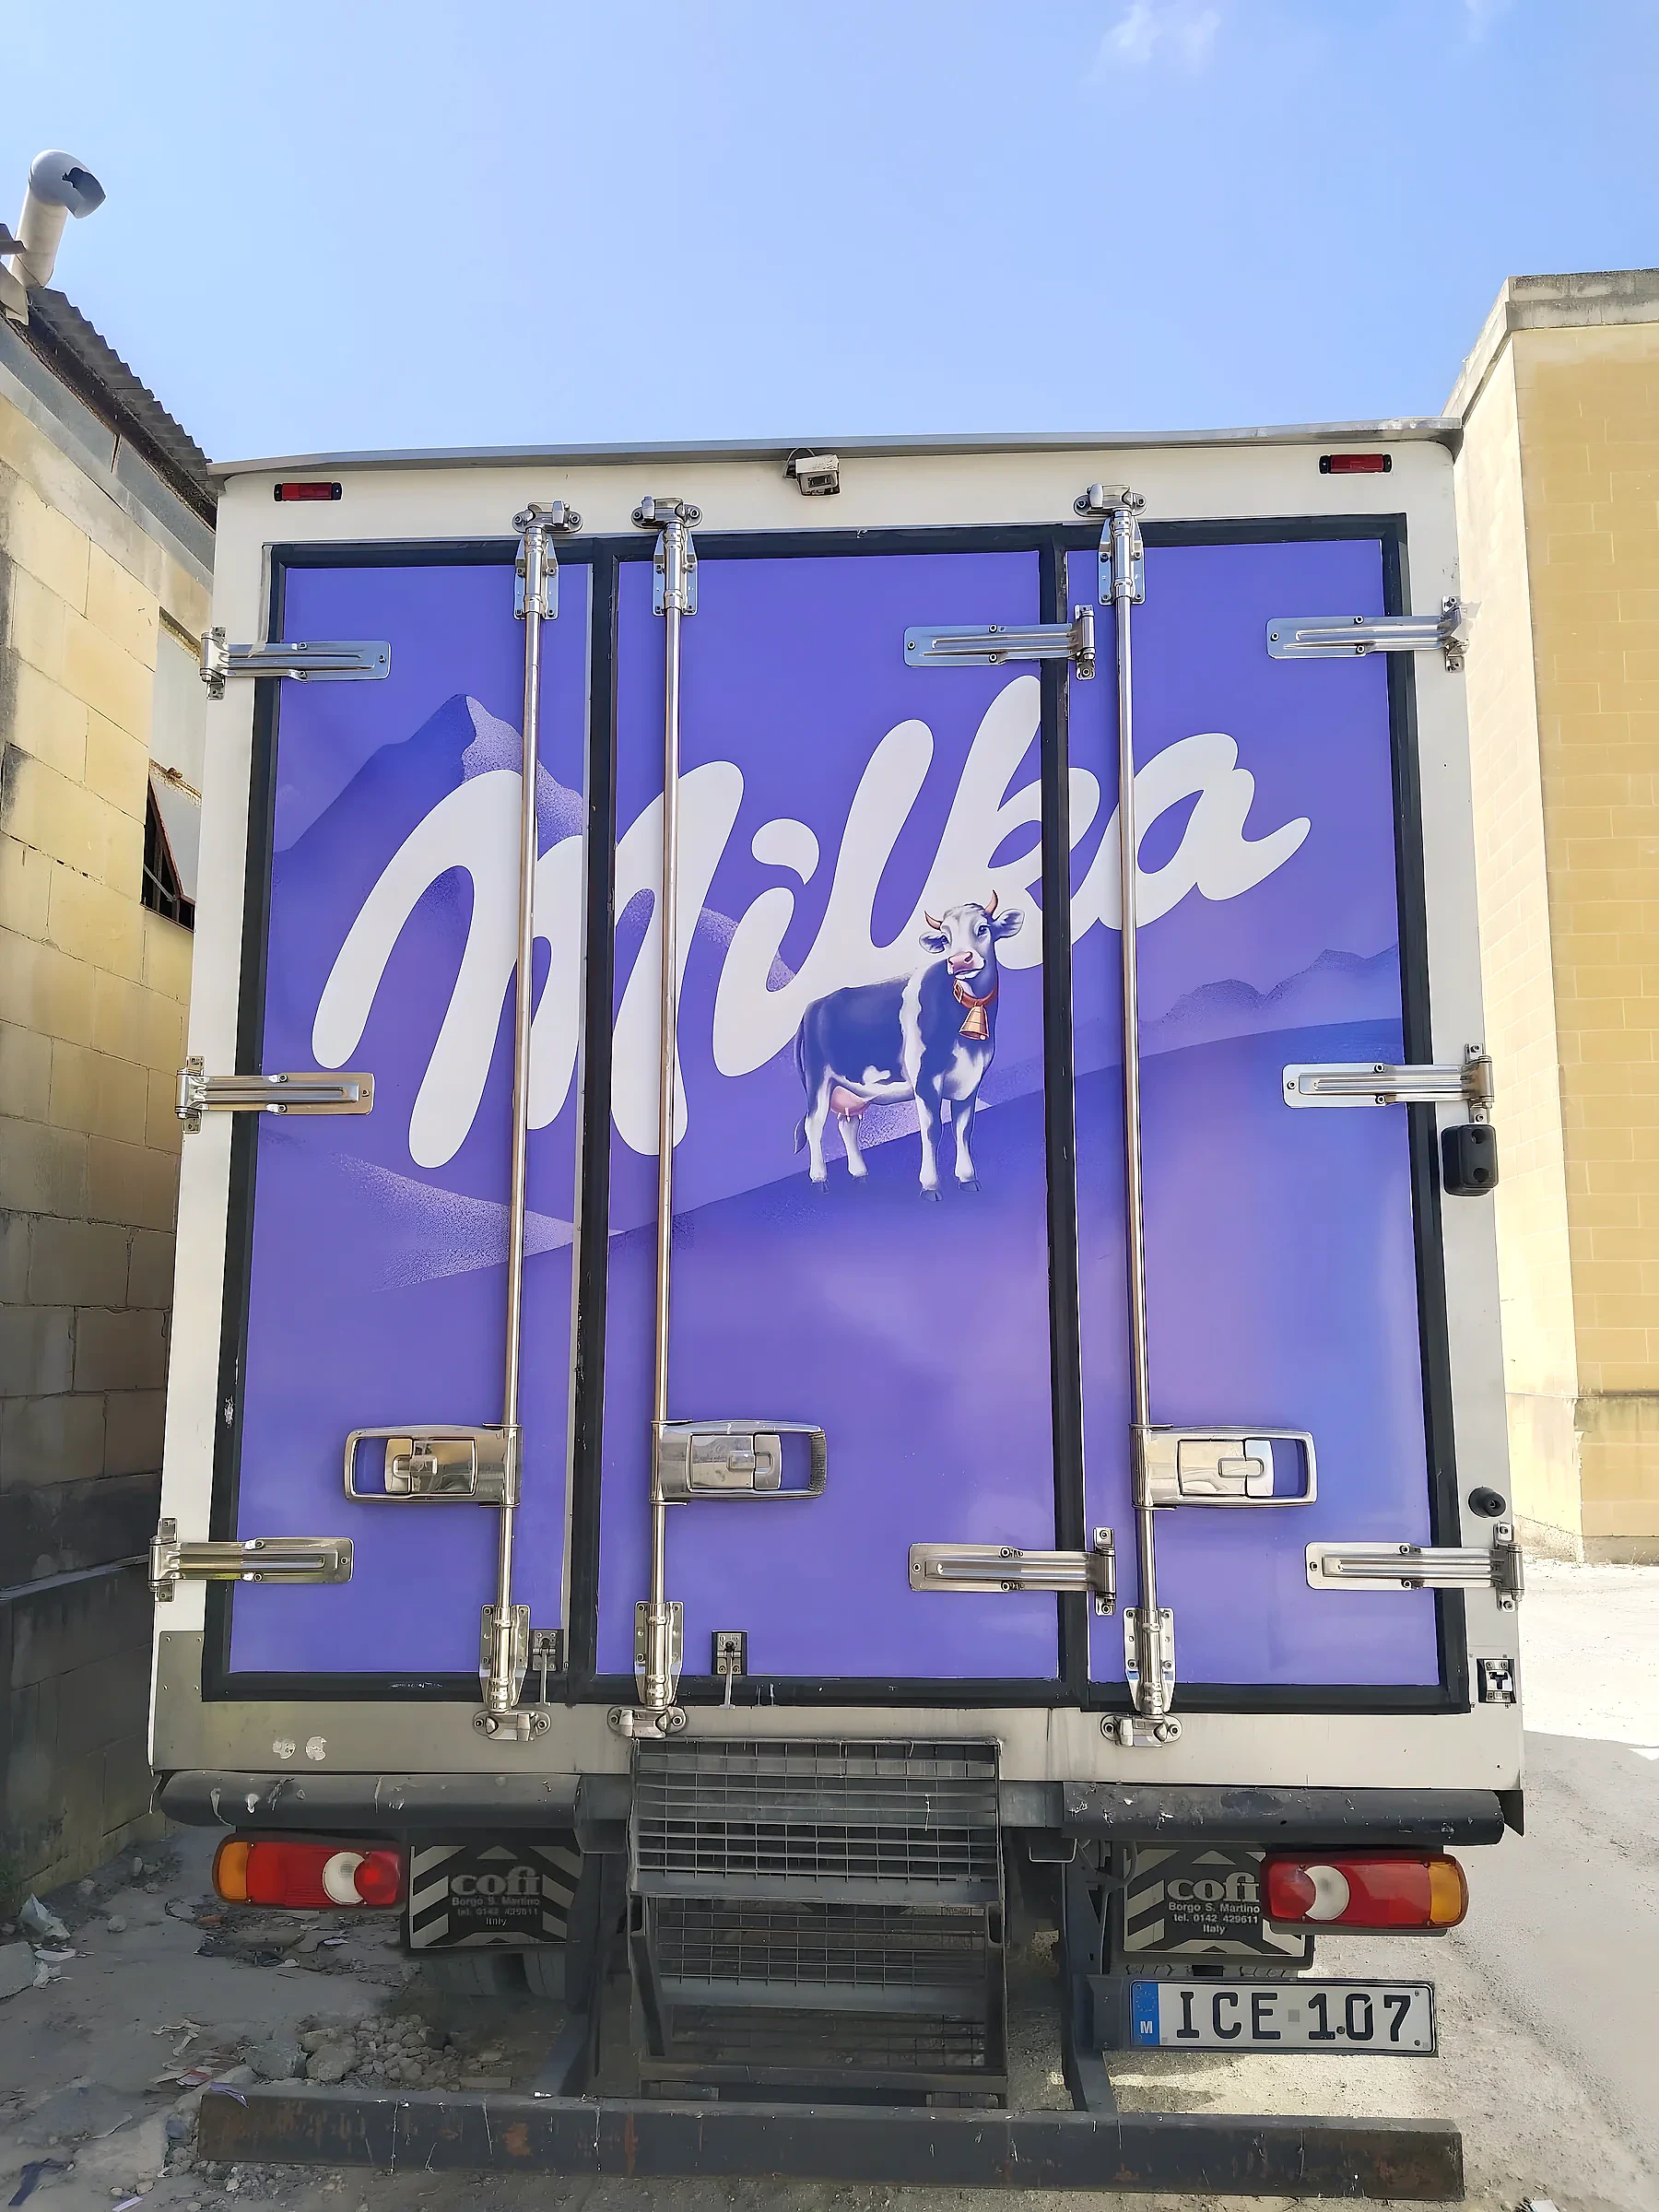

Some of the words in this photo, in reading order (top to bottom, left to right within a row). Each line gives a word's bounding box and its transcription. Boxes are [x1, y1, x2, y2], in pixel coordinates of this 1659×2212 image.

[312, 675, 1312, 1169] Milka
[451, 1865, 540, 1896] cofi
[1167, 1871, 1260, 1902] cofi
[452, 1897, 484, 1907] Borgo
[1168, 1901, 1201, 1913] Borgo
[1206, 1902, 1216, 1912] S.
[1219, 1903, 1260, 1913] Martino
[1173, 1913, 1189, 1923] tel.
[1194, 1913, 1218, 1923] 0142
[1203, 1924, 1226, 1936] Italy
[1176, 1991, 1281, 2041] ICE
[1308, 1993, 1412, 2041] 107
[1140, 2020, 1153, 2034] M
